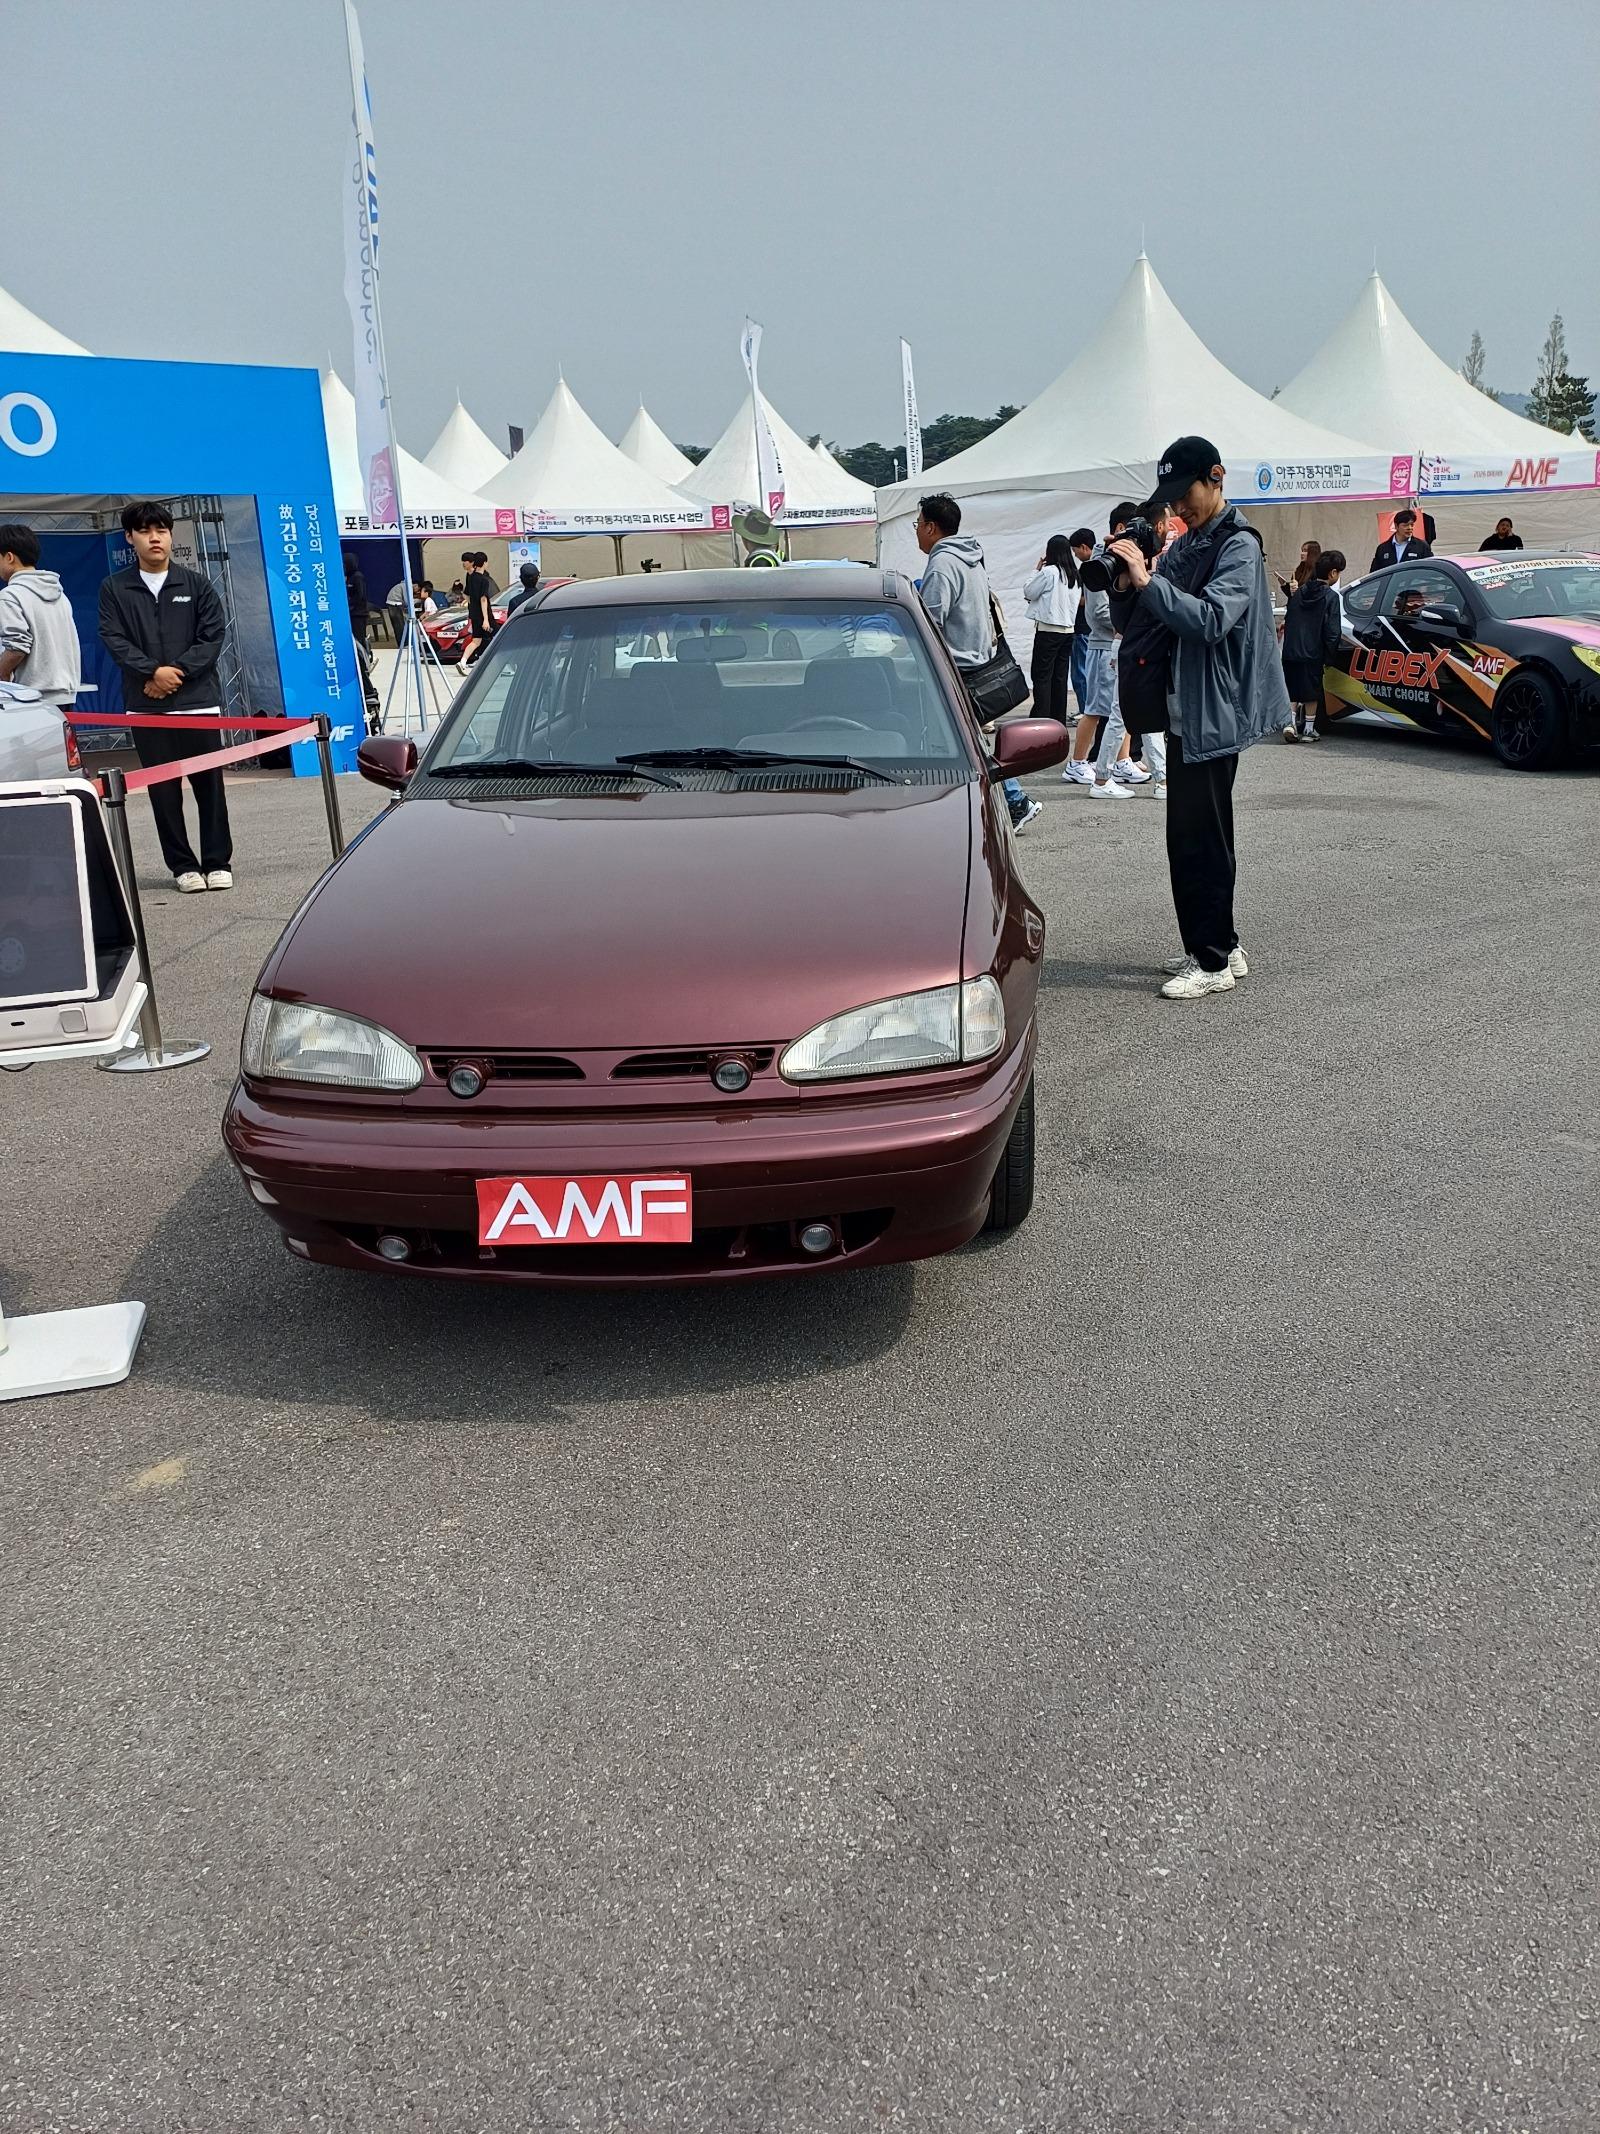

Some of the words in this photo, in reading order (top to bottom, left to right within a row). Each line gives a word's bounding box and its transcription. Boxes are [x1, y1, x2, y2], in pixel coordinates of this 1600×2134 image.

[1276, 464, 1351, 480] 아주자동차대학교
[1505, 457, 1559, 488] AMF
[1276, 480, 1294, 491] AJOU
[1295, 480, 1320, 490] MOTOR
[1322, 479, 1350, 489] COLLEGE
[304, 504, 323, 554] 당신의
[432, 515, 469, 530] 만들기
[574, 514, 651, 525] 아주자동차대학교
[653, 513, 677, 524] RISE
[677, 512, 703, 523] 사업단
[1511, 562, 1542, 570] MOTOR
[312, 562, 330, 611] 정신을
[288, 589, 311, 650] 회장님
[318, 620, 342, 700] 계승합니다
[1349, 647, 1451, 690] LUBEX
[1473, 655, 1505, 674] AMF
[1364, 683, 1393, 698] SMART
[1394, 688, 1430, 703] CHOICE
[484, 1180, 687, 1240] AMF
